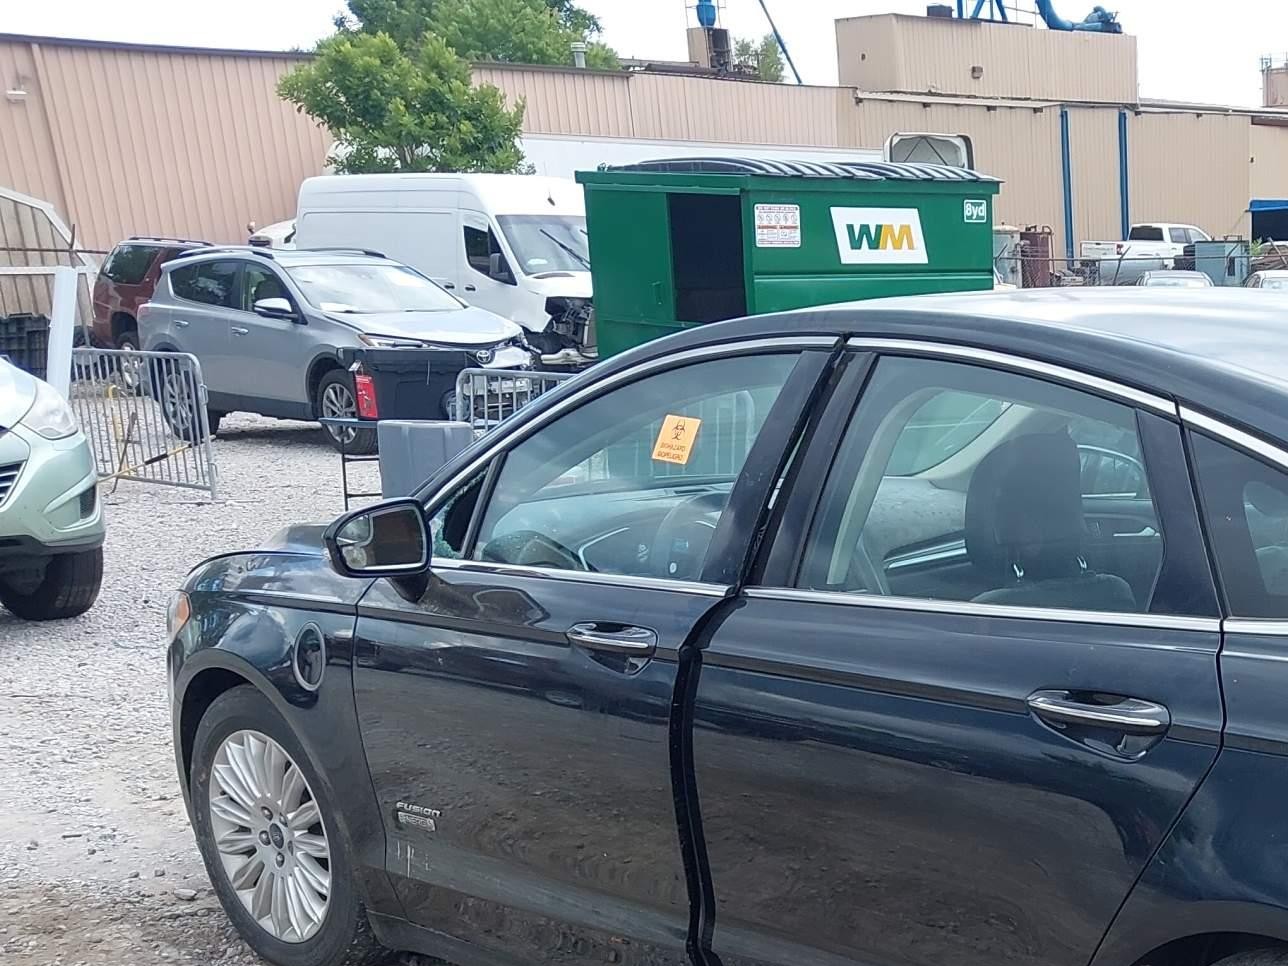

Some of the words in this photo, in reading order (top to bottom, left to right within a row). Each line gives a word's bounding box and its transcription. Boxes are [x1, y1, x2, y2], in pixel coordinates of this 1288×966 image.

[965, 203, 985, 220] 8yd
[846, 223, 914, 251] WM
[396, 801, 441, 818] FUSION
